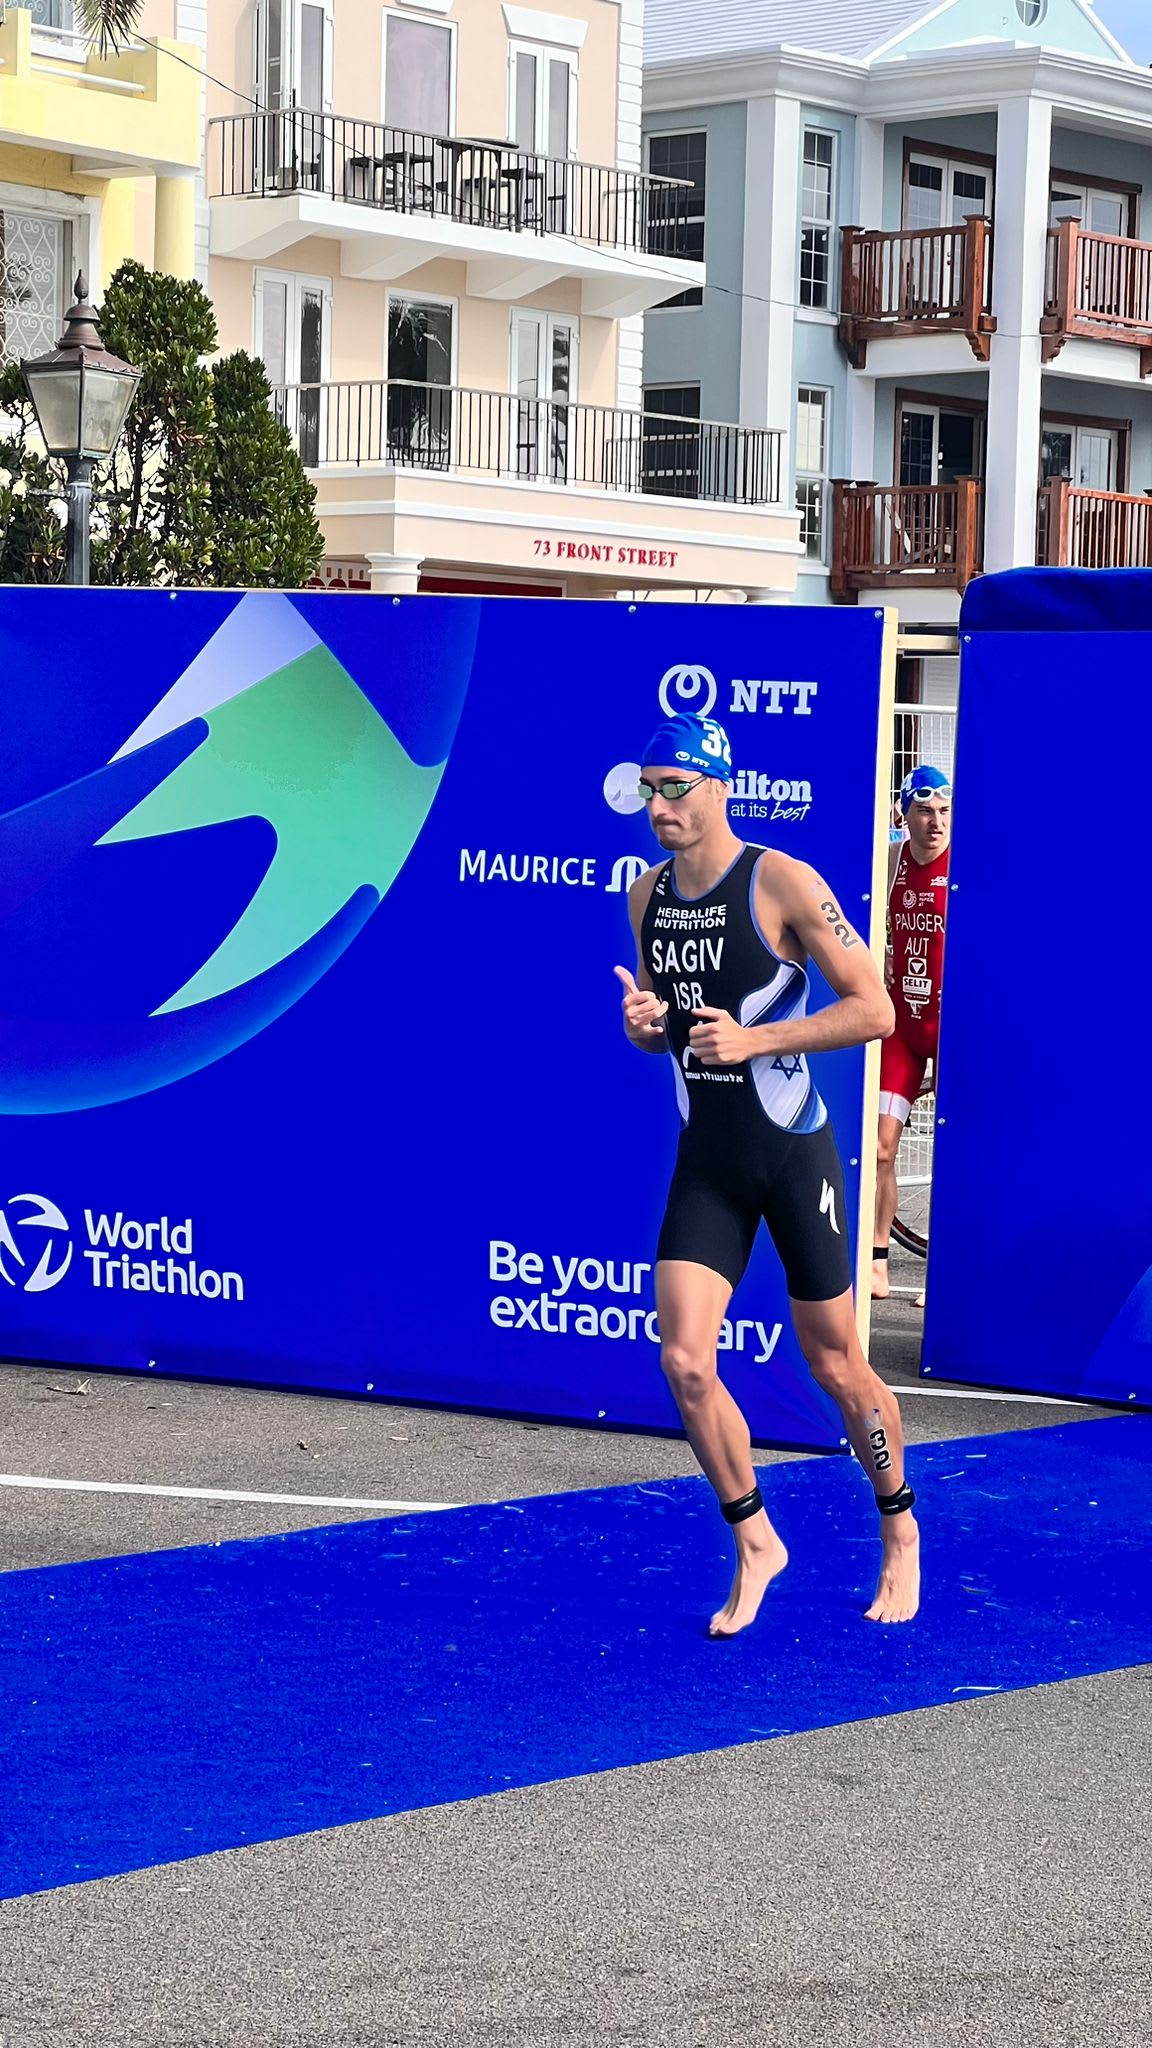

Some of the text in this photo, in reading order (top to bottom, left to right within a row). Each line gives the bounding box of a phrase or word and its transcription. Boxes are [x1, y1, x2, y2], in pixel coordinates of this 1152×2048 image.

[533, 540, 678, 568] 73 FRONT STREET
[729, 680, 818, 715] NTT
[728, 769, 813, 802] ilton
[730, 801, 811, 821] at its best
[459, 848, 596, 886] MAURICE
[654, 916, 726, 930] NUTRITION
[657, 904, 727, 919] HERBALIFE
[820, 901, 858, 948] 32
[895, 912, 945, 933] PAUGER
[652, 936, 724, 974] SAGIV
[904, 937, 930, 957] AUT
[672, 981, 706, 1011] ISR
[904, 978, 929, 988] SELIT
[84, 1209, 192, 1255] World
[83, 1250, 244, 1301] Triathlon
[489, 1240, 651, 1297] Be your
[489, 1292, 783, 1363] extraorary
[869, 1428, 893, 1471] 32
